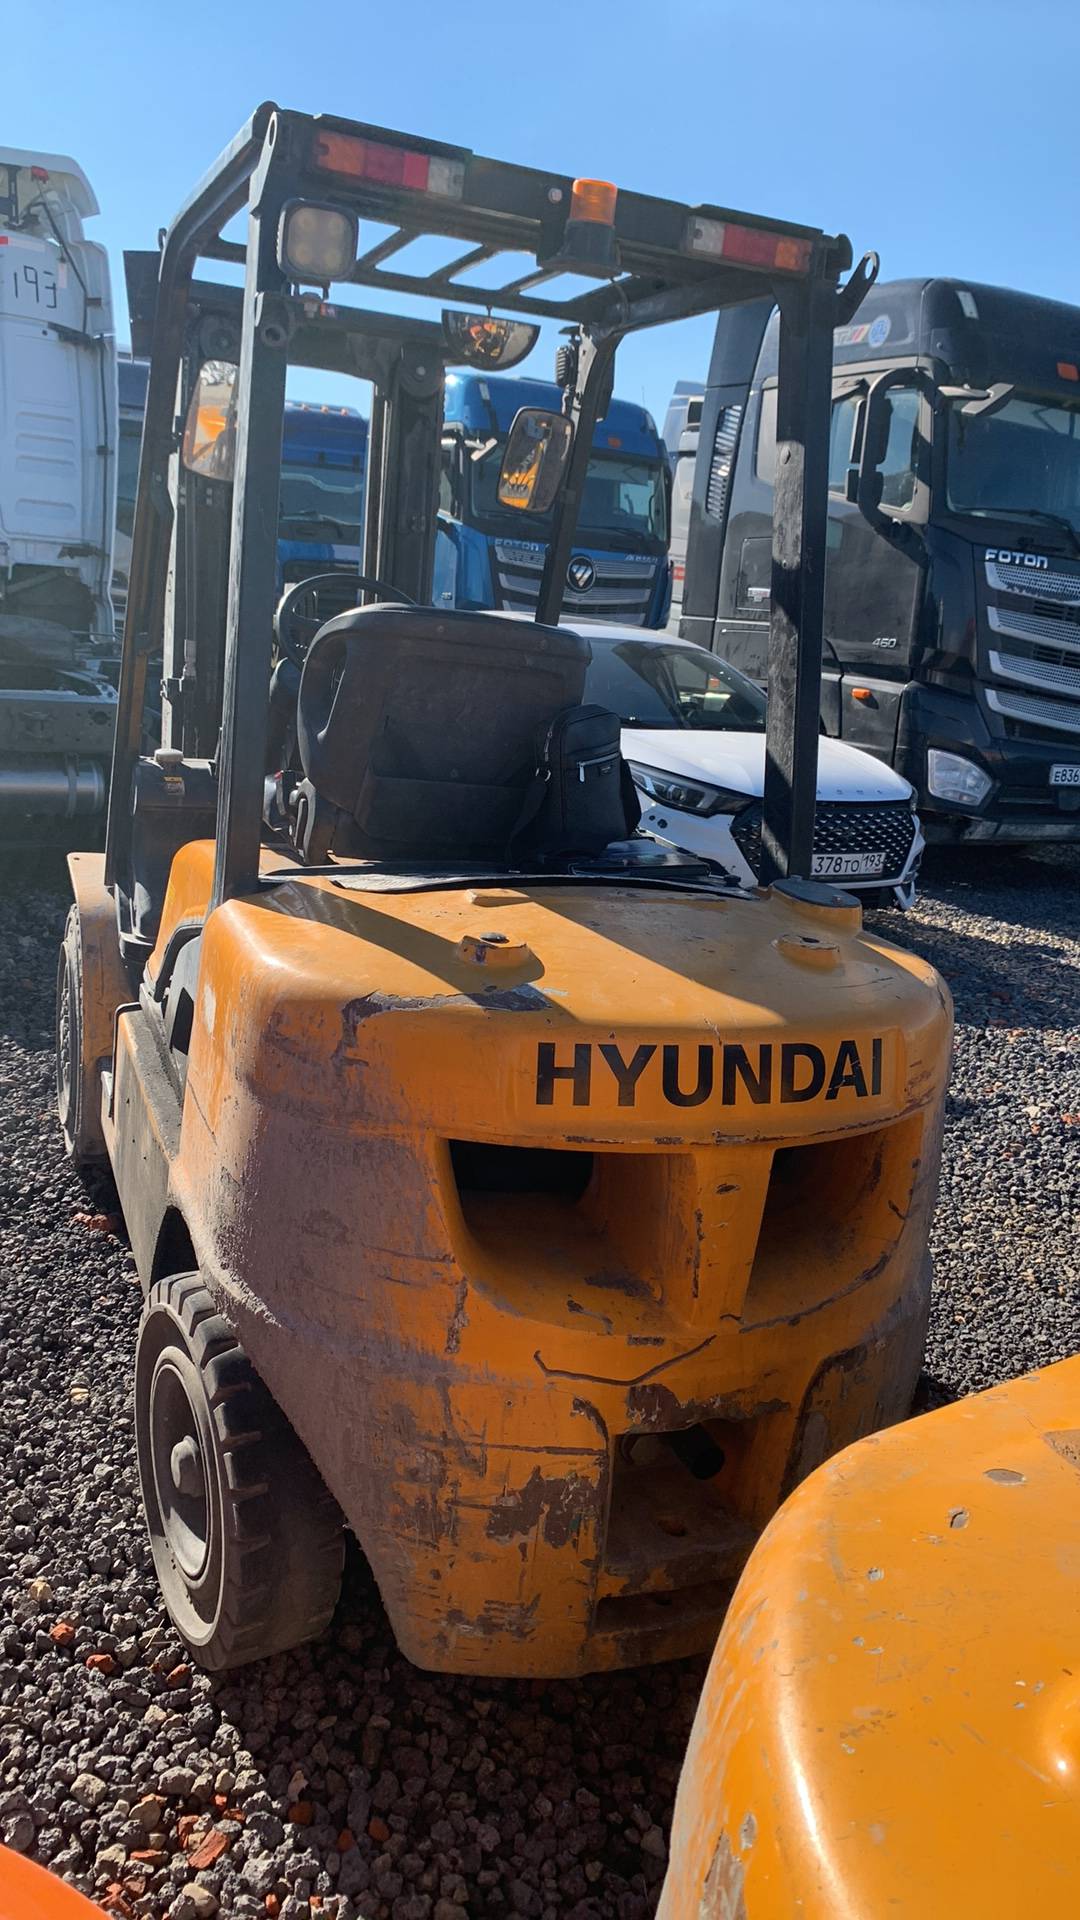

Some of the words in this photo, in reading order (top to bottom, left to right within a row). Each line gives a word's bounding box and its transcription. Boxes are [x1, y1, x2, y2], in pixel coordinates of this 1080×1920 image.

[984, 548, 1049, 569] FOTON
[871, 637, 897, 649] 460
[1054, 768, 1080, 783] E836
[814, 856, 860, 874] 378TO
[862, 854, 883, 868] 193
[535, 1037, 882, 1107] HYUNDAI
